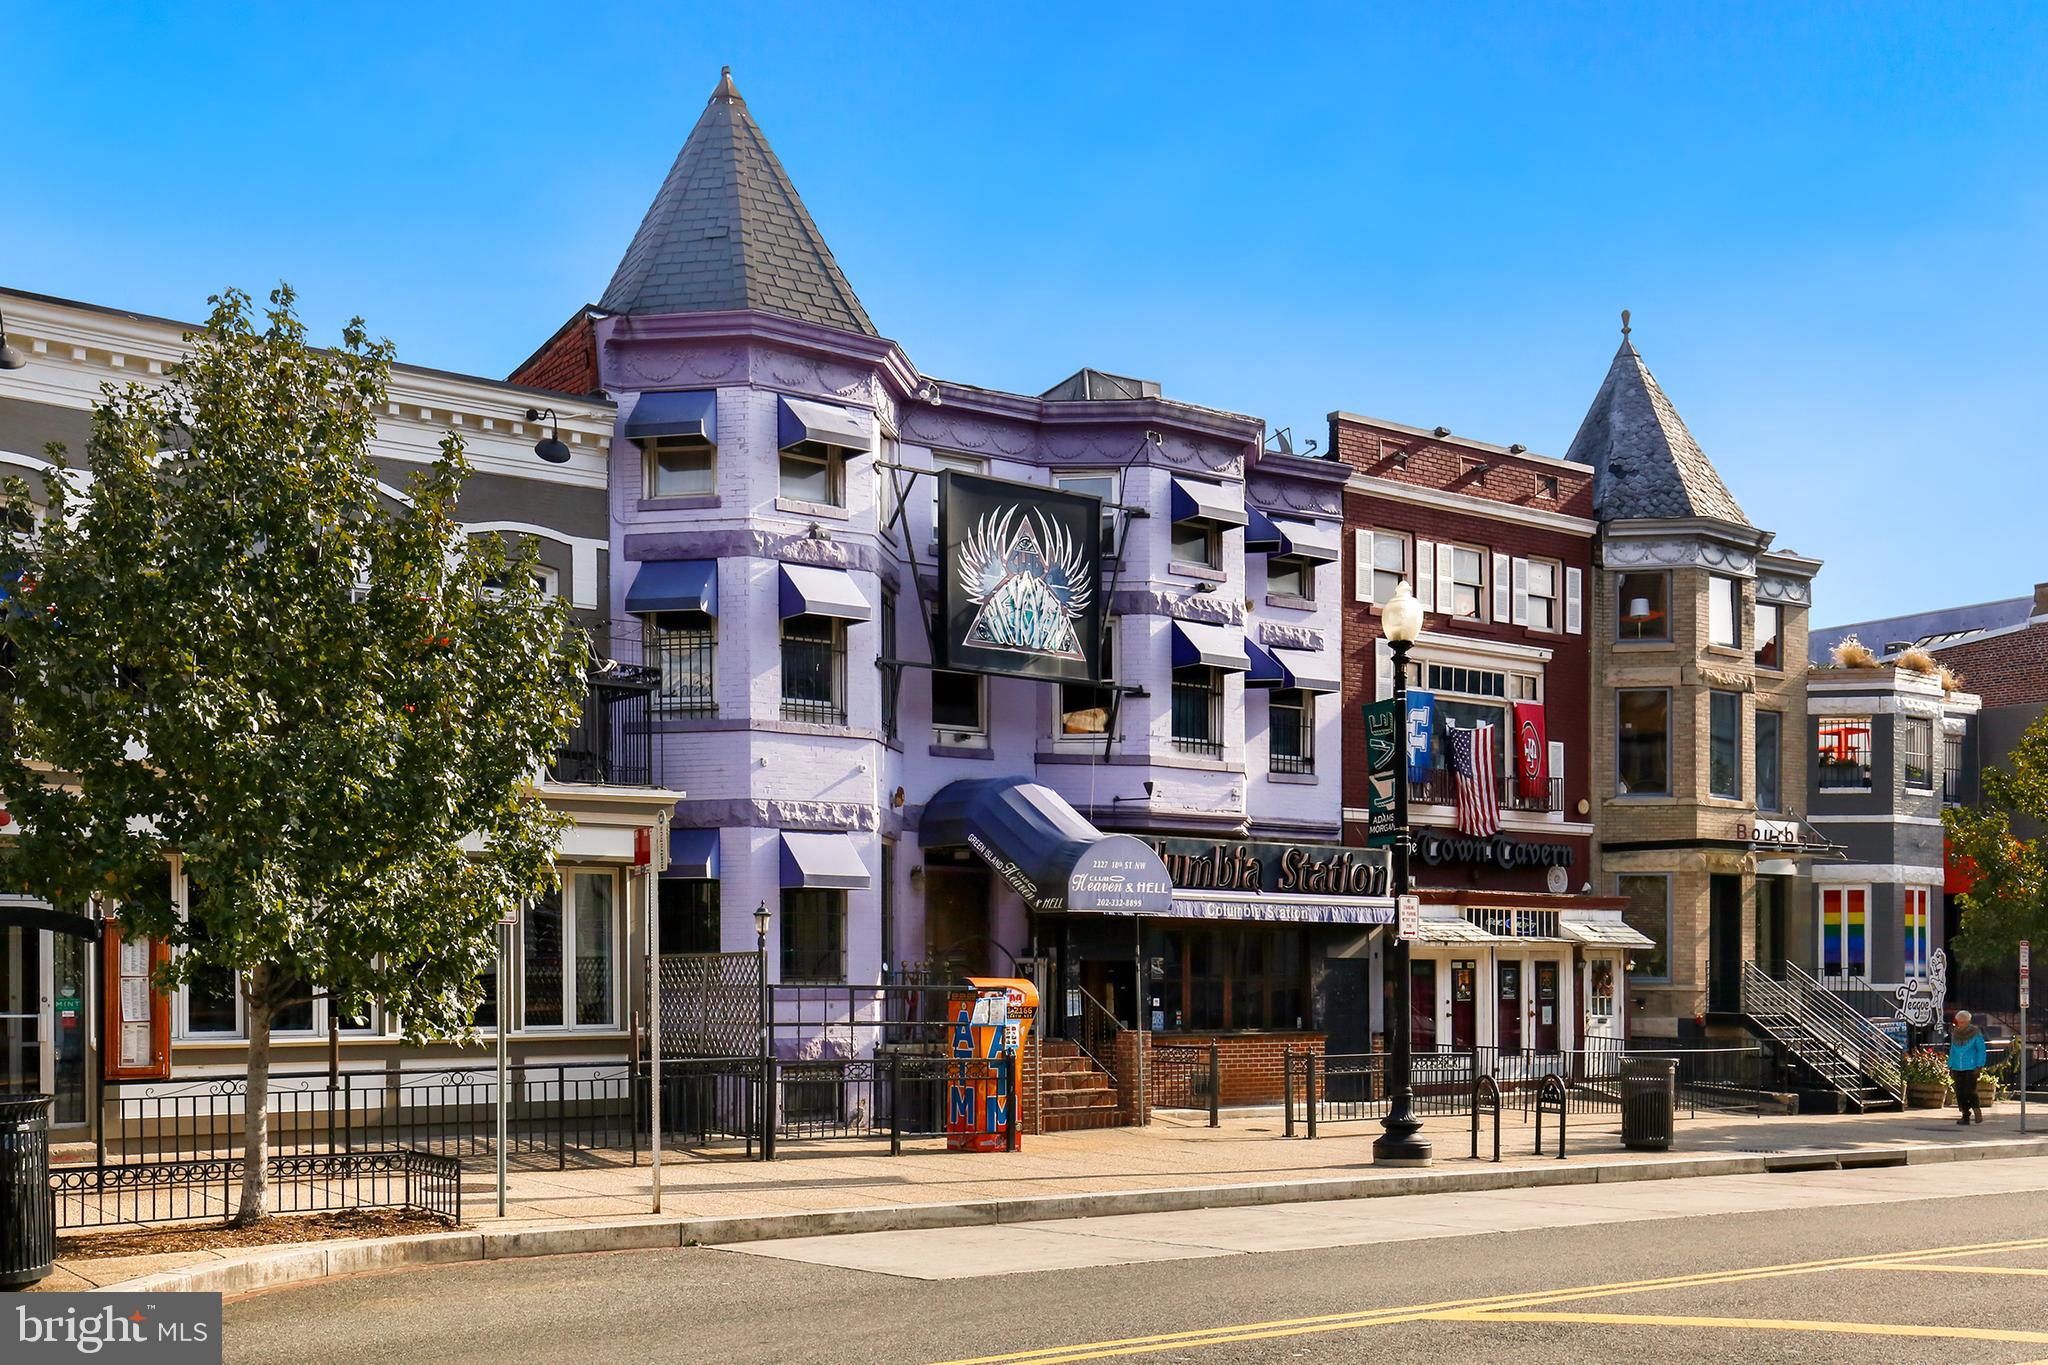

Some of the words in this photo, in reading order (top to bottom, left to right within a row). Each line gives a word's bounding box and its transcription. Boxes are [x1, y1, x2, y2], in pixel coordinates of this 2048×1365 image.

[1373, 812, 1395, 825] ADAMS
[967, 833, 987, 853] GREEN
[984, 848, 1004, 870] ISLAND
[1417, 827, 1488, 866] Town
[1491, 831, 1574, 869] Tavern
[1134, 862, 1146, 870] NW
[1278, 846, 1389, 896] Station
[1072, 873, 1122, 893] Heaven
[1125, 882, 1134, 893] &
[1137, 882, 1168, 894] HELL
[1042, 898, 1063, 909] HELL
[1206, 902, 1265, 919] Columbia
[1266, 904, 1309, 920] Station
[55, 999, 81, 1008] MINT
